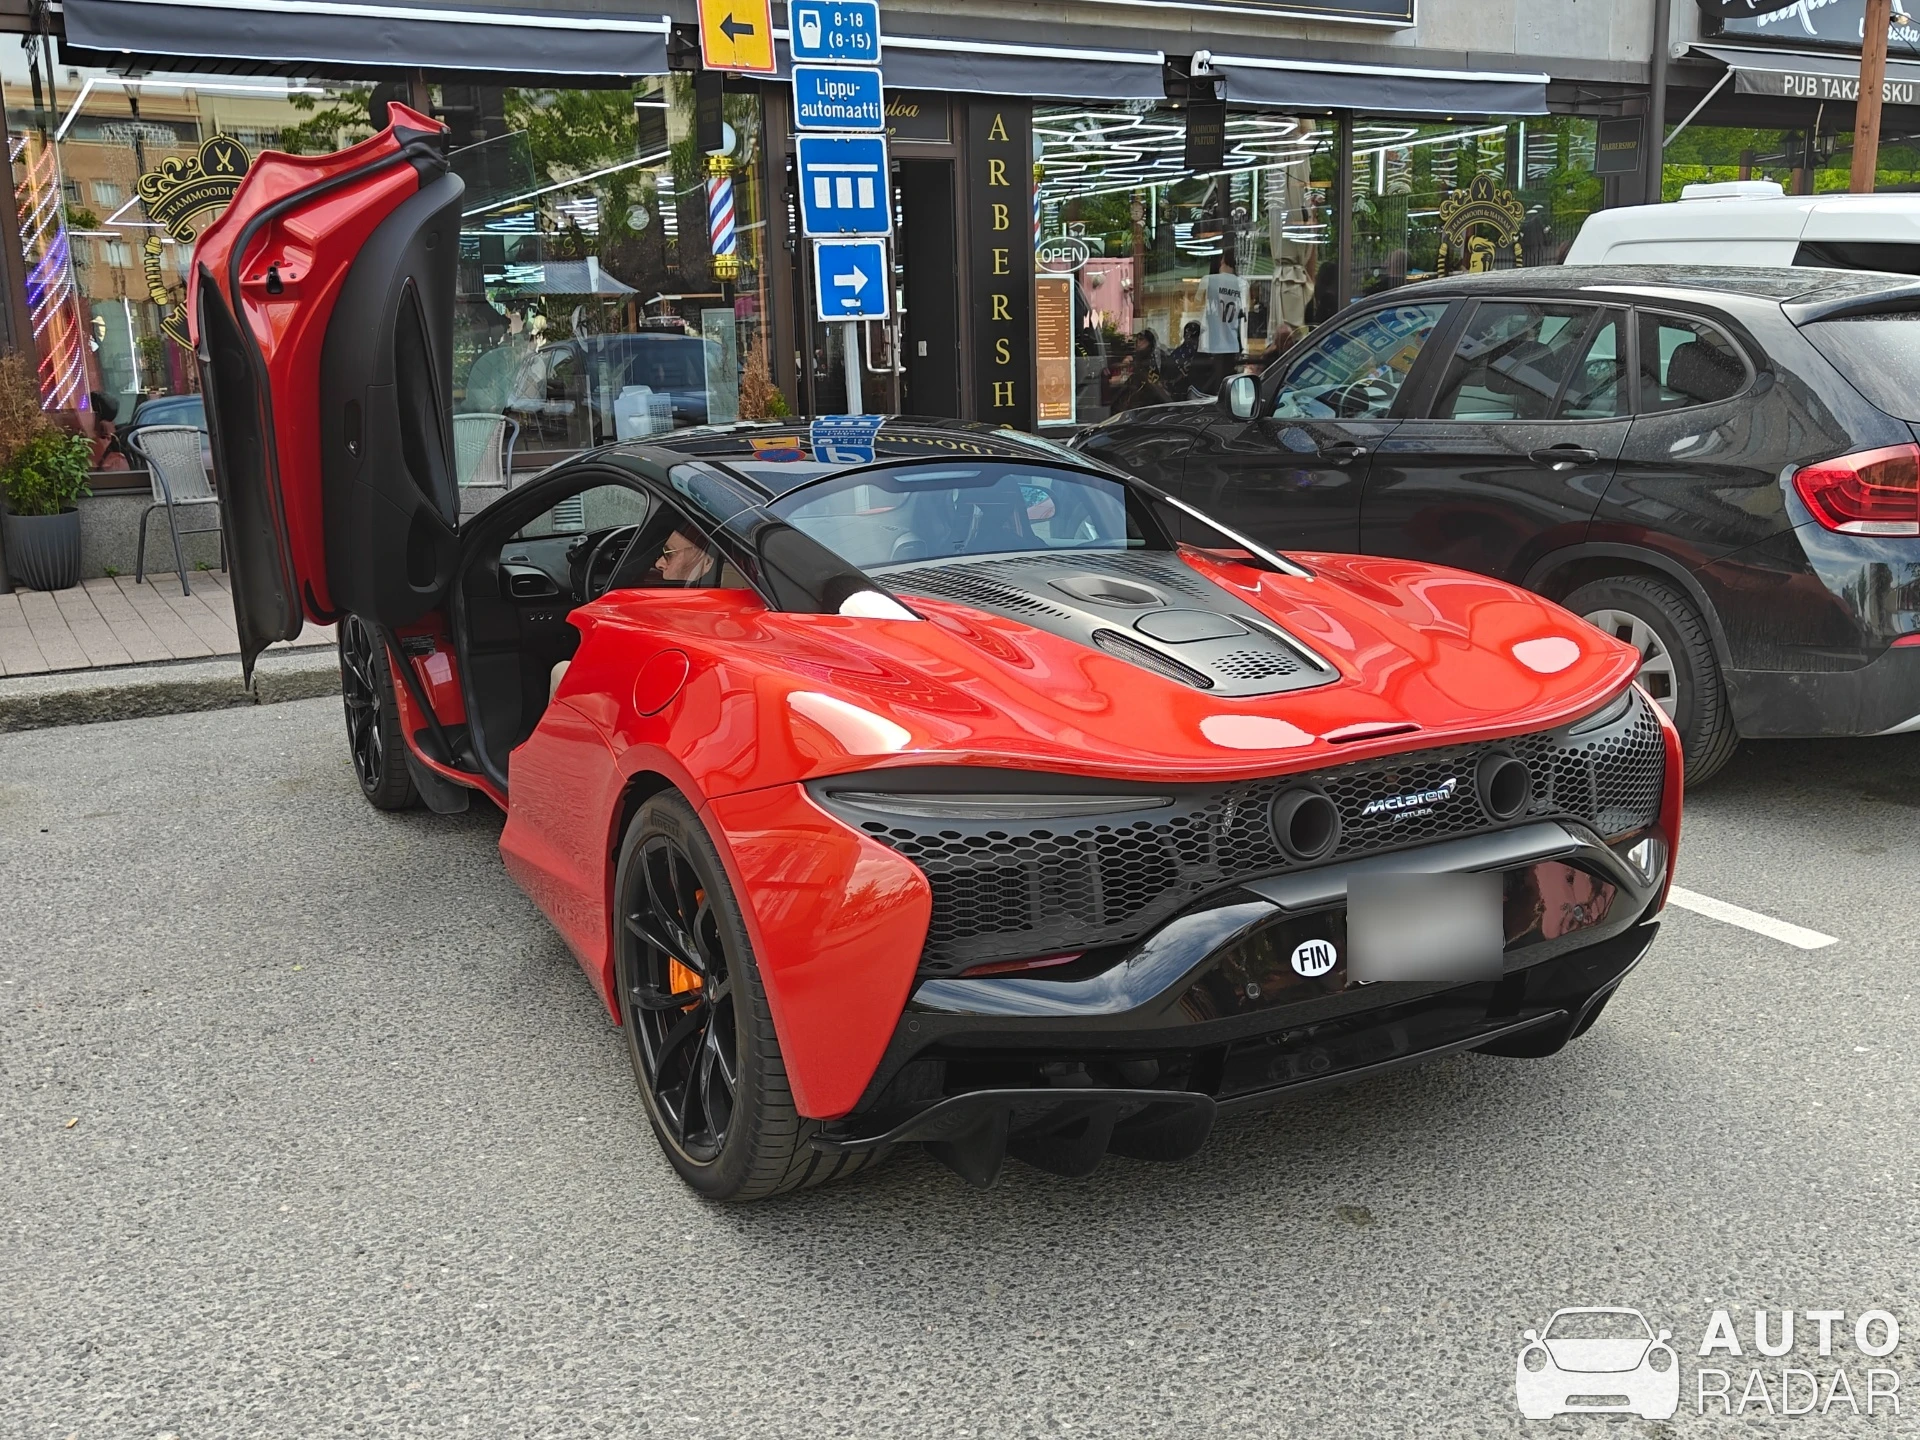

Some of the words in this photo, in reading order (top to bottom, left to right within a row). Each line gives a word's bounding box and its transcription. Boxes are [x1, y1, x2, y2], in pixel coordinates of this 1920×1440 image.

[834, 11, 863, 28] 8-18
[828, 31, 871, 50] (8-15)
[816, 78, 861, 99] Lippu-
[1784, 75, 1817, 96] PUB
[1822, 78, 1913, 103] TAKASKU
[800, 100, 879, 119] automaatti
[167, 186, 229, 215] HAMMOODI
[1451, 209, 1483, 230] HAMMOODI
[1041, 247, 1083, 263] OPEN
[1361, 789, 1451, 816] McLaren
[650, 807, 681, 838] PIRELLI
[1394, 808, 1434, 821] ARTURA
[1298, 944, 1331, 972] FIN
